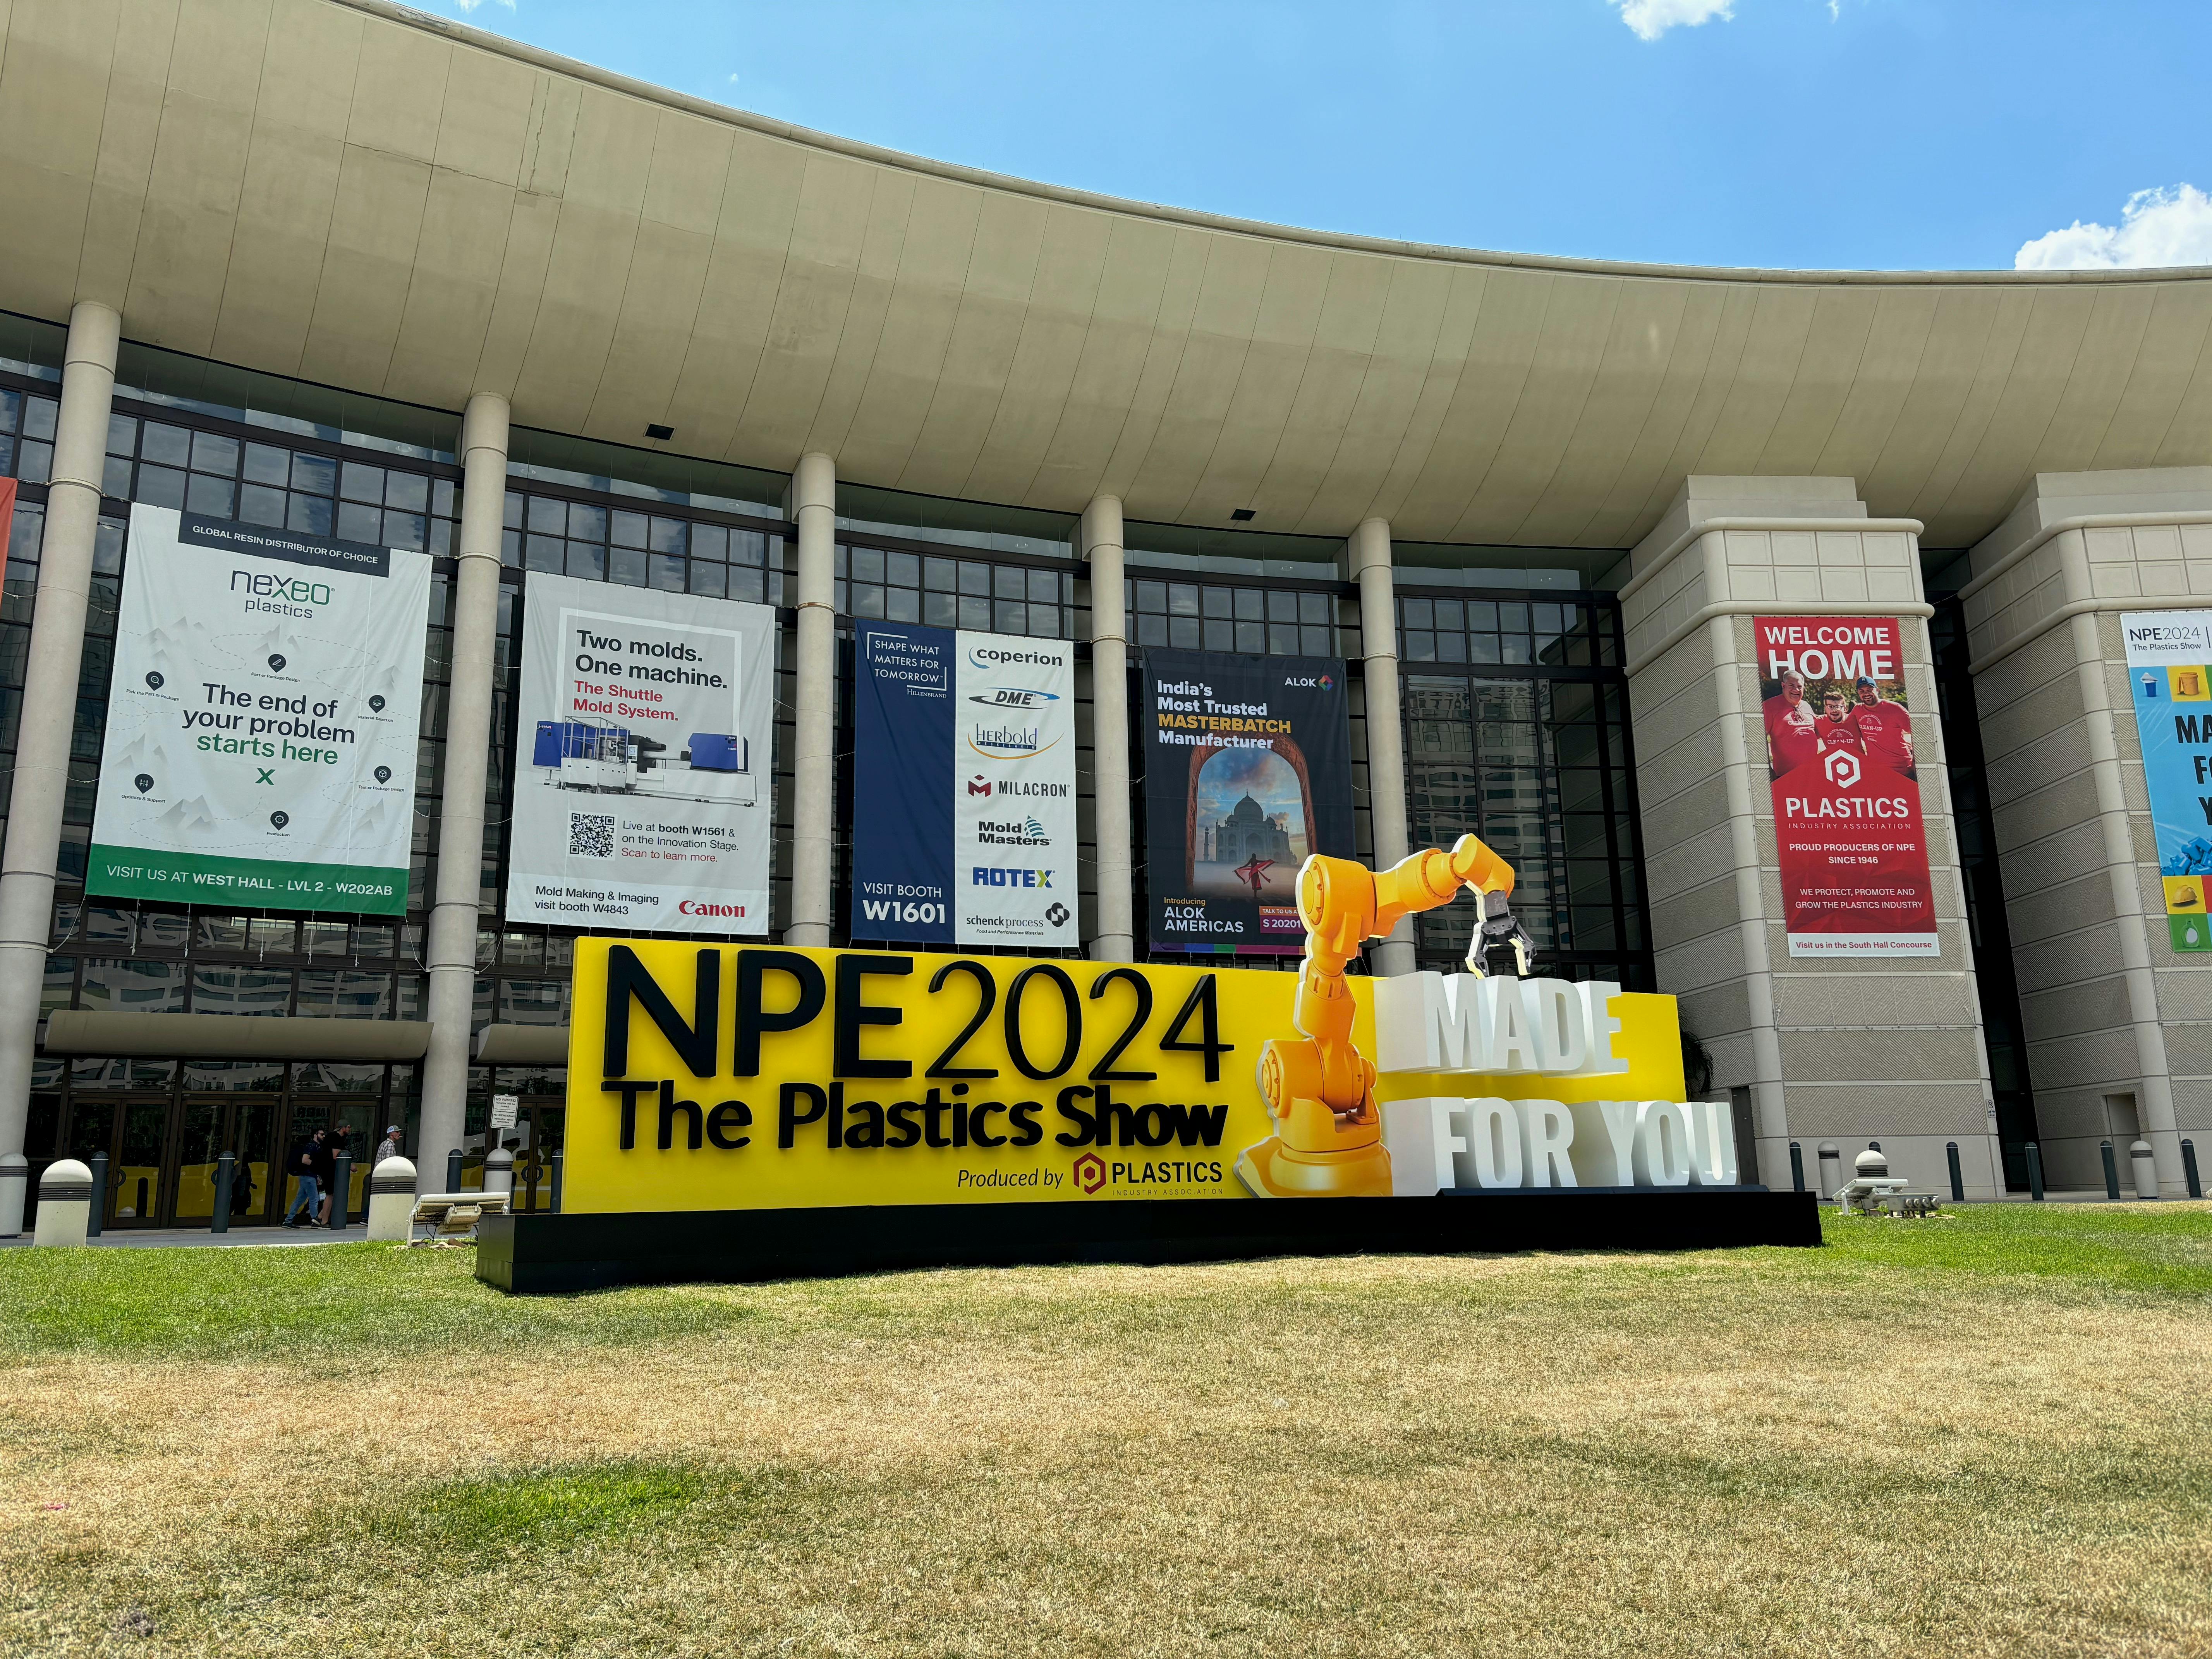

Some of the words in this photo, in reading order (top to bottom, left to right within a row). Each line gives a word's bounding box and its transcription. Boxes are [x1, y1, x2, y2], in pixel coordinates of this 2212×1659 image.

[193, 526, 232, 539] GLOBAL
[234, 533, 263, 544] RESIN
[266, 539, 327, 555] DISTRIBUTOR
[343, 552, 378, 563] CHOICE
[245, 598, 312, 618] plastics
[1764, 627, 1890, 644] WELCOME
[2130, 627, 2200, 641] NPE2024
[577, 630, 622, 651] Two
[630, 641, 702, 661] molds.
[875, 641, 906, 651] SHAPE
[910, 644, 939, 654] WHAT
[875, 654, 917, 666] MATTERS
[921, 659, 939, 669] FOR
[977, 649, 1062, 666] coperion
[1769, 650, 1894, 680] HOME
[576, 654, 622, 675] One
[629, 666, 727, 689] machine.
[875, 669, 939, 682] TOMORROW
[574, 680, 603, 694] The
[608, 685, 663, 702] Shuttle
[1285, 677, 1316, 687] ALOK
[203, 683, 251, 707] The
[259, 694, 307, 714] end
[313, 700, 338, 718] of
[995, 690, 1033, 705] DME
[1158, 697, 1200, 712] Most
[1204, 700, 1267, 716] Trusted
[574, 698, 612, 713] Mold
[618, 703, 678, 721] System.
[182, 710, 243, 729] your
[249, 717, 355, 744] problem
[1158, 714, 1290, 733] MASTERBATCH
[197, 733, 275, 757] starts
[282, 739, 337, 764] here
[1159, 730, 1273, 749] Manufacturer
[999, 781, 1066, 797] MILACRON
[1786, 798, 1908, 817] PLASTICS
[623, 821, 642, 830] Live
[659, 824, 688, 834] booth
[692, 826, 724, 836] W1561
[729, 829, 735, 837] &
[979, 821, 1021, 833] Mold
[638, 835, 654, 844] the
[658, 836, 706, 848] Innovation
[710, 840, 738, 852] Stage.
[979, 833, 1050, 846] Masters
[622, 848, 646, 857] Scan
[651, 850, 659, 859] to
[664, 851, 686, 860] learn
[107, 865, 143, 878] VISIT
[148, 869, 167, 880] US
[171, 872, 189, 882] AT
[193, 873, 235, 886] WEST
[238, 877, 275, 889] HALL
[288, 881, 311, 891] LVL
[315, 882, 323, 891] 2
[336, 883, 392, 895] W202AB
[973, 867, 1053, 888] ROTEX
[536, 886, 562, 896] Mold
[566, 888, 604, 901] Making
[608, 891, 615, 900] &
[619, 892, 658, 905] Imaging
[863, 882, 893, 895] VISIT
[898, 885, 941, 898] BOOTH
[535, 900, 555, 909] visit
[560, 902, 589, 912] booth
[593, 904, 628, 914] W4843
[679, 900, 745, 917] Canon
[1164, 897, 1205, 906] Introducing
[863, 900, 945, 923] W1601
[1164, 907, 1205, 919] ALOK
[1165, 920, 1243, 932] AMERICAS
[1263, 919, 1269, 927] S
[1272, 919, 1300, 927] 20201
[602, 943, 1235, 1084] NPE2024
[1424, 971, 1629, 1074] MADE
[599, 1078, 753, 1152] The
[778, 1081, 1045, 1149] Plastics
[1055, 1083, 1229, 1148] Show
[1431, 1097, 1578, 1188] FOR
[1597, 1100, 1737, 1187] YOU
[958, 1168, 1038, 1187] Produced
[1044, 1168, 1063, 1189] by
[1113, 1162, 1222, 1183] PLASTICS
